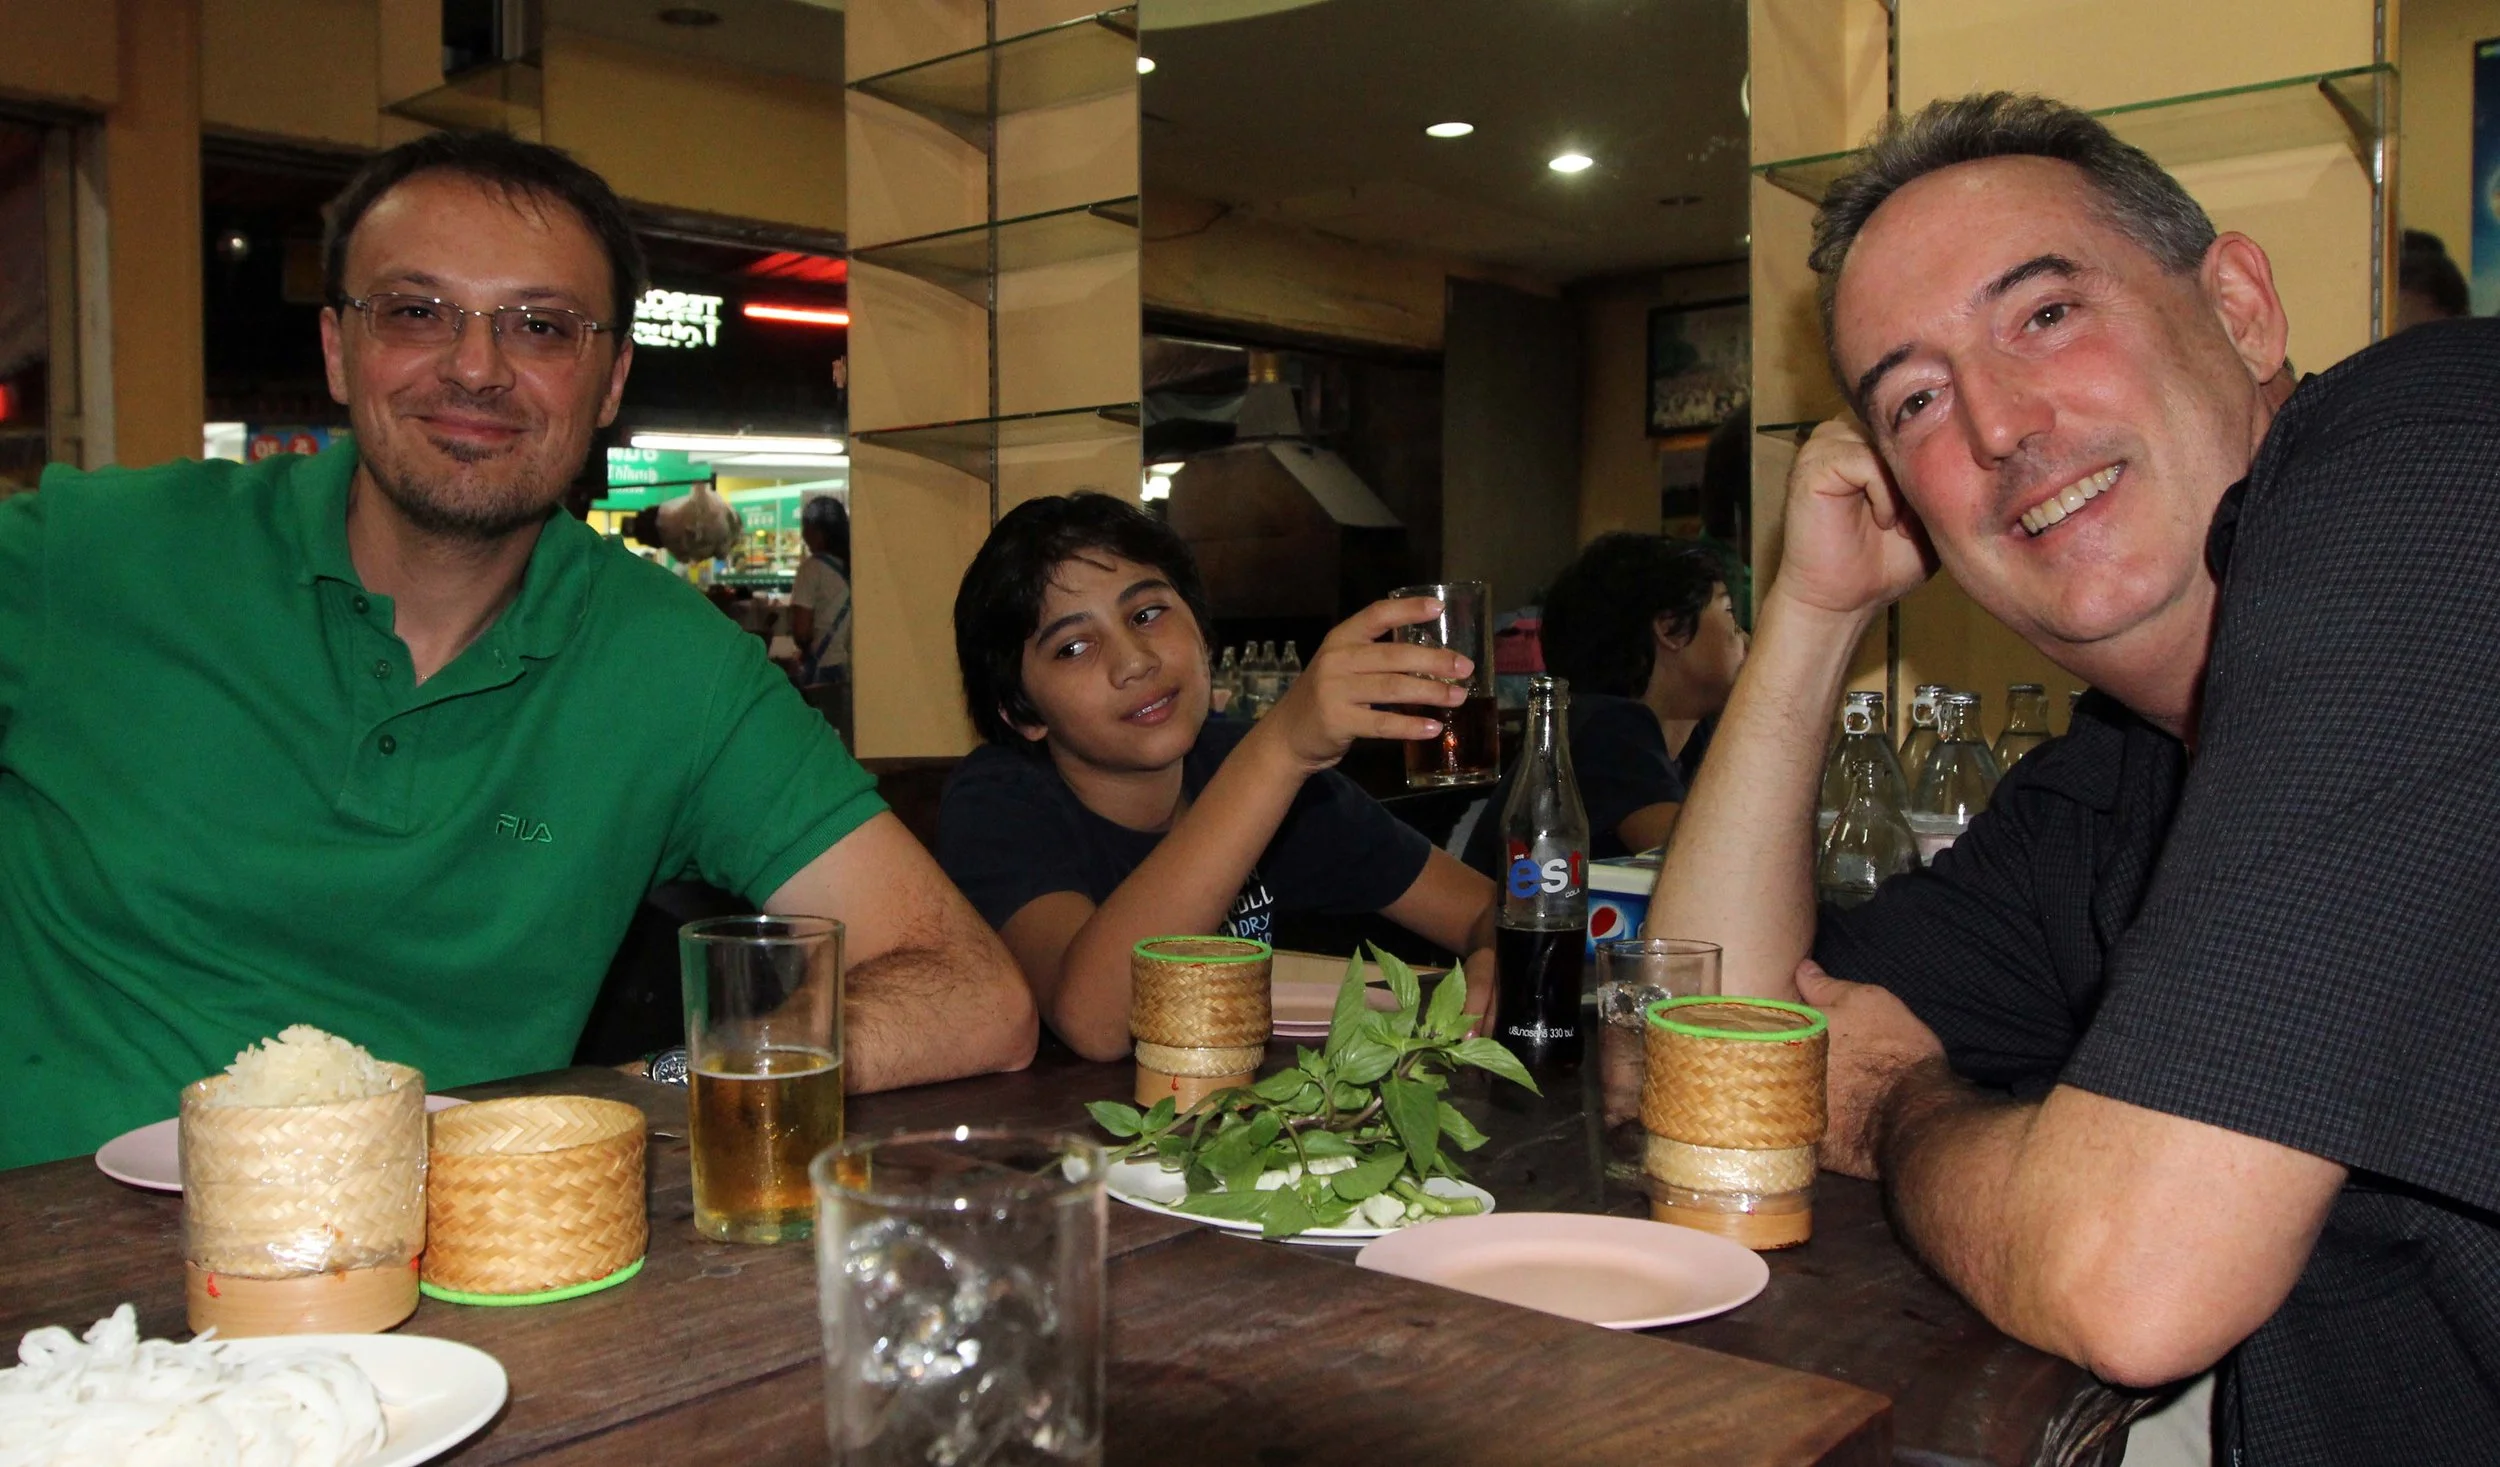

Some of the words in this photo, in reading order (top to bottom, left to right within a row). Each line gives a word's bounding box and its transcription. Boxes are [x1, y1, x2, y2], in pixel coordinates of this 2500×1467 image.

[495, 813, 553, 843] FILA
[1508, 850, 1583, 899] est
[1565, 888, 1581, 899] COLA
[1239, 912, 1271, 937] DRY
[1549, 1028, 1563, 1038] 330
